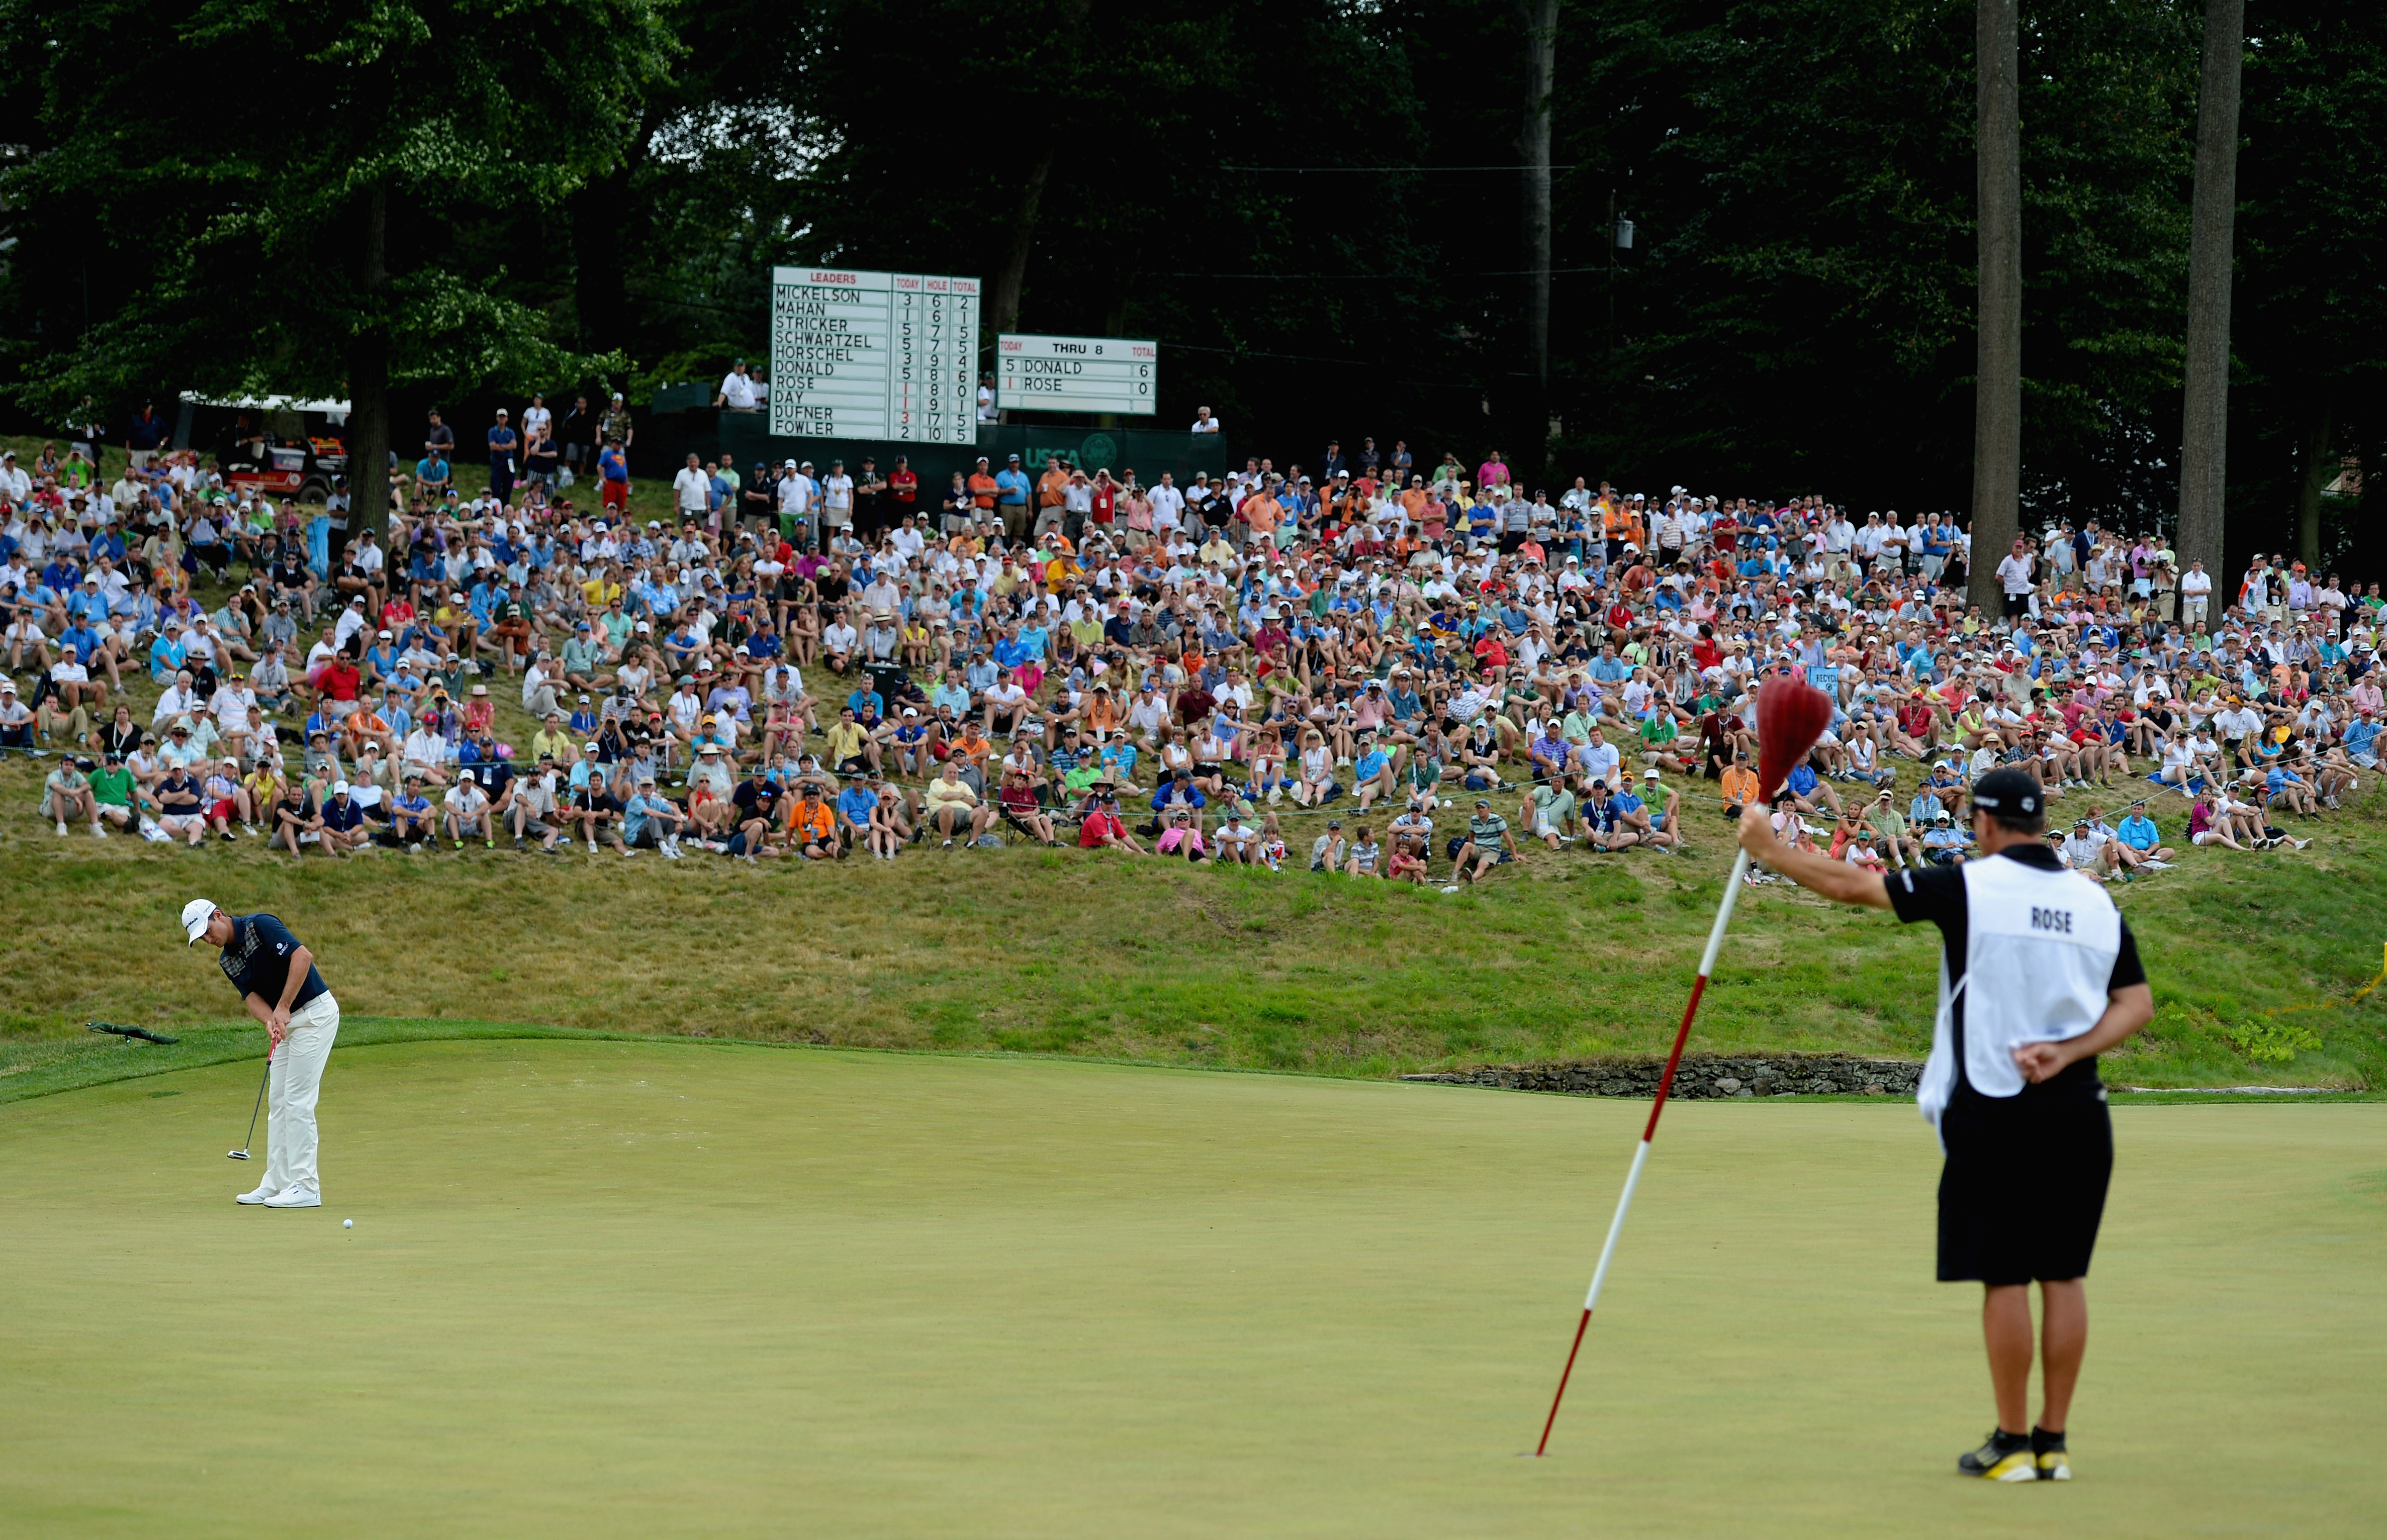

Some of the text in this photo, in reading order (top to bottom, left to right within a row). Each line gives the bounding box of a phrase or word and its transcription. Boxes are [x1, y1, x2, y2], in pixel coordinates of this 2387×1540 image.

[810, 272, 976, 293] LEADERS TODAY HOLE TOTAL
[777, 286, 967, 310] MICKELSON 3 6 2
[776, 301, 825, 316] MAHAN
[933, 310, 941, 323] 6
[775, 316, 968, 339] STRICKER 5 7 5
[775, 331, 967, 353] SCHWARTZEL 5 7 5
[999, 341, 1155, 357] TODAY THRU 8 TOTAL
[775, 346, 966, 368] HORSCHEL 3 9 4
[775, 360, 966, 383] DONALD 5 8 6
[1006, 359, 1148, 377] 5 DONALD 6
[777, 376, 814, 389] ROSE
[931, 383, 938, 396] 8
[958, 385, 966, 398] 0
[1025, 378, 1062, 391] ROSE
[1139, 382, 1147, 395] 0
[775, 391, 804, 404] DAY
[930, 398, 938, 411] 9
[775, 406, 966, 427] DUFNER 3 17 5
[775, 421, 965, 441] FOWLER 2 10 5
[1816, 674, 1839, 682] RECYCL
[2032, 906, 2072, 934] ROSE
